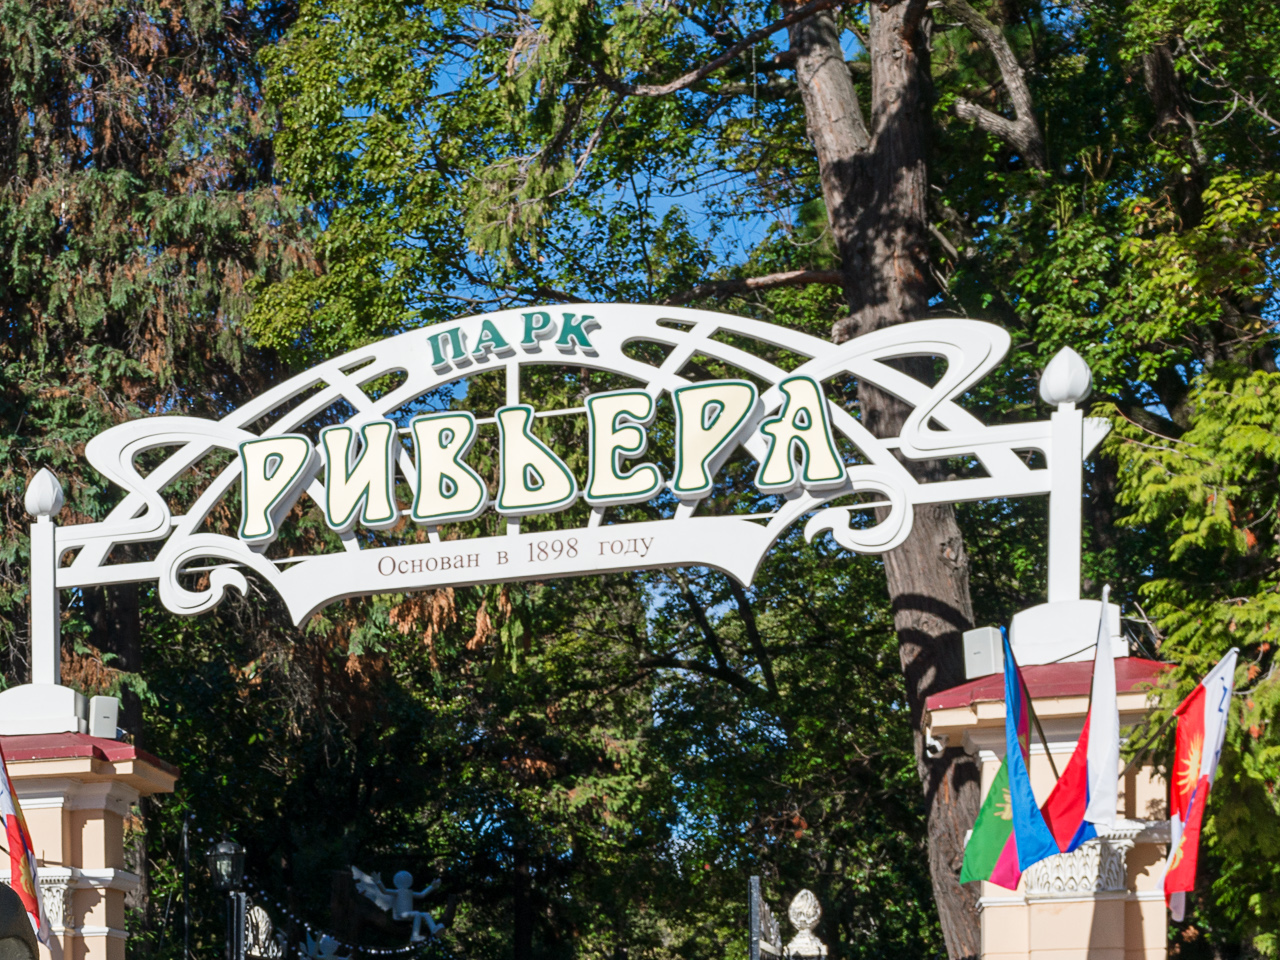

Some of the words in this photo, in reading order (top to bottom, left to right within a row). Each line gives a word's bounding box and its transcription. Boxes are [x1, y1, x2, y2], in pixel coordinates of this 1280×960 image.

[426, 311, 599, 370] ПАРК
[237, 373, 849, 543] РИВЬЕРА
[377, 552, 480, 576] Основан
[497, 551, 509, 566] в
[527, 537, 579, 562] 1898
[599, 536, 655, 558] году
